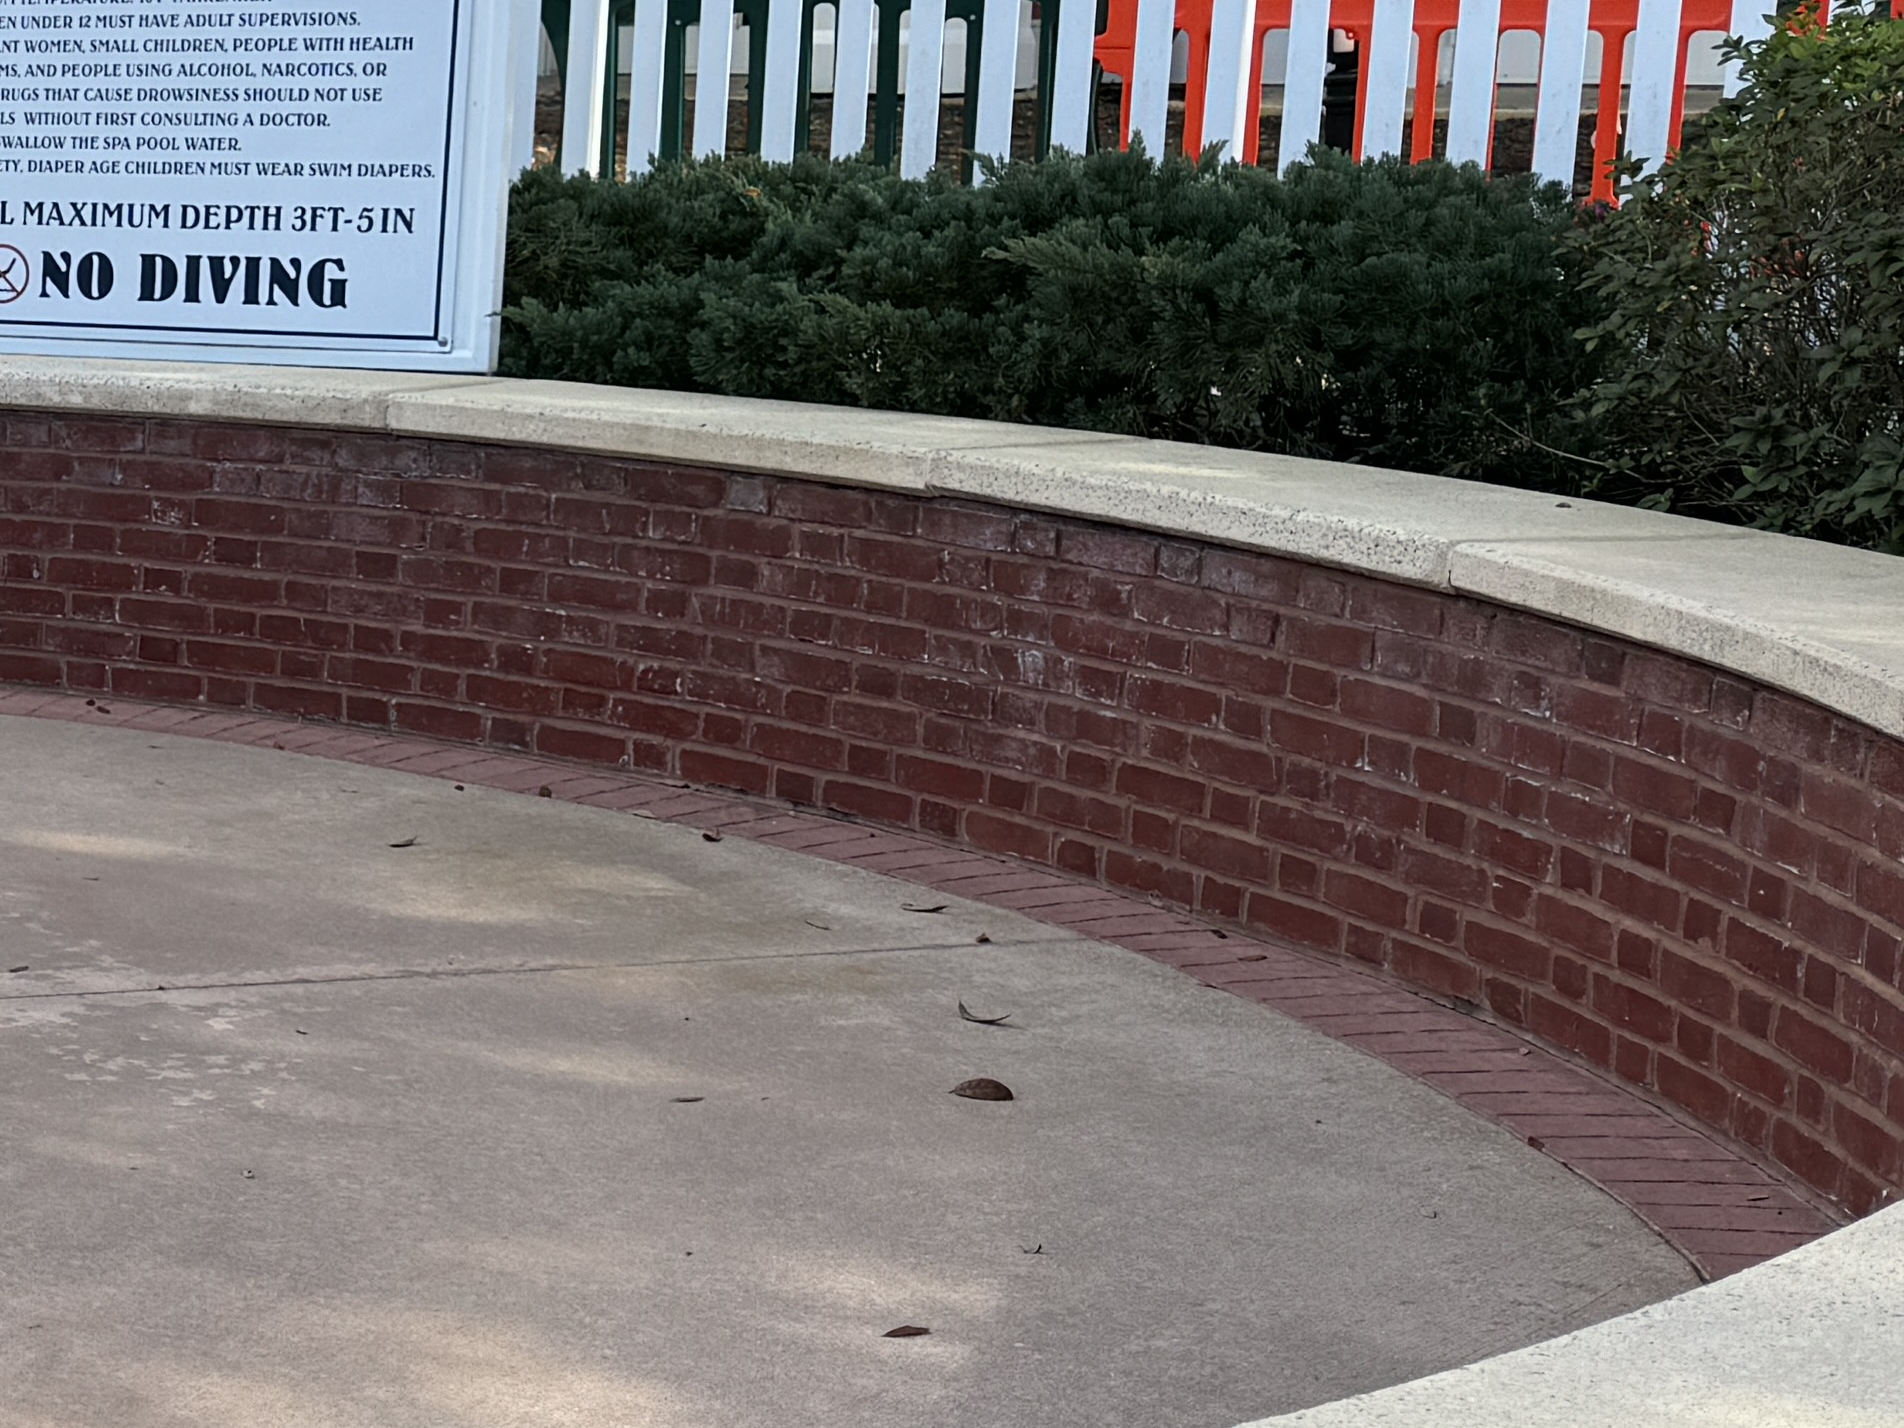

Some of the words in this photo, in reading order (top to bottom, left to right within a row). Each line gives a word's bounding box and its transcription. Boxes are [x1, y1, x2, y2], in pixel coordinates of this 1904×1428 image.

[20, 15, 73, 30] UNDER
[78, 14, 92, 29] 12
[94, 14, 136, 29] MUST
[138, 13, 180, 28] HAVE
[183, 12, 236, 28] ADULT
[237, 11, 361, 28] SUPERVISIONS.
[23, 39, 86, 54] WOMEN,
[89, 38, 140, 53] SMALL
[142, 37, 229, 54] CHILDREN,
[232, 37, 299, 53] PEOPLE
[302, 36, 345, 52] WITH
[349, 36, 414, 52] HEALTH
[24, 63, 58, 78] AND
[60, 63, 122, 78] PEOPLE
[125, 62, 173, 78] USING
[176, 62, 257, 78] ALCOHOL,
[261, 62, 358, 78] NARCOTICS,
[361, 62, 388, 77] OR
[43, 87, 81, 102] THAT
[83, 87, 133, 102] CAUSE
[136, 87, 240, 103] DROWSINESS
[242, 87, 310, 103] SHOULD
[313, 87, 348, 102] NOT
[351, 87, 383, 102] USE
[23, 111, 92, 127] WITHOUT
[95, 111, 138, 127] FIRST
[140, 111, 239, 127] CONSULTING
[242, 112, 255, 127] A
[259, 112, 331, 127] DOCTOR.
[69, 135, 100, 150] THE
[102, 136, 132, 151] SPA
[135, 136, 180, 151] POOL
[184, 136, 242, 152] WATER.
[27, 159, 85, 174] DIAPER
[87, 160, 121, 175] AGE
[124, 160, 206, 176] CHILDREN
[209, 161, 252, 176] MUST
[255, 162, 305, 177] WEAR
[308, 162, 353, 178] SWIM
[356, 163, 436, 179] DIAPERS.
[22, 200, 172, 230] MAXIMUM
[179, 204, 284, 232] DEPTH
[38, 250, 115, 301] NO
[136, 252, 349, 310] DIVING
